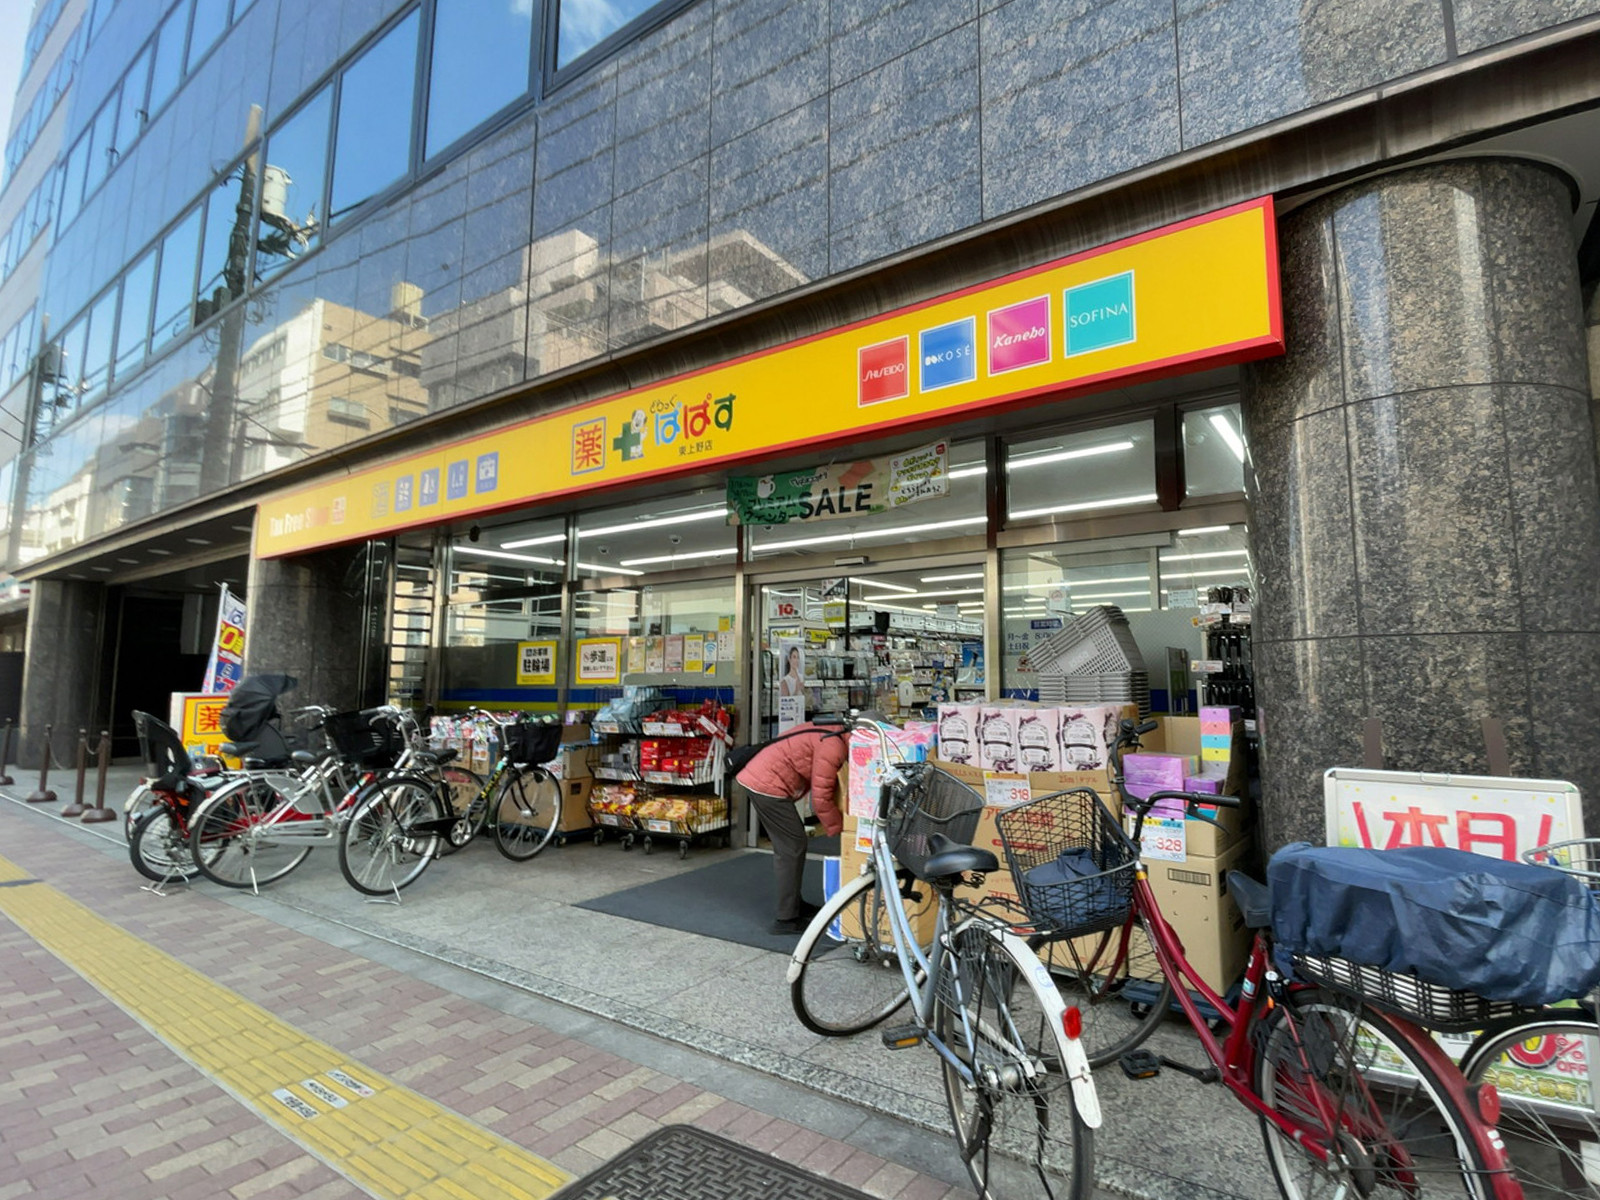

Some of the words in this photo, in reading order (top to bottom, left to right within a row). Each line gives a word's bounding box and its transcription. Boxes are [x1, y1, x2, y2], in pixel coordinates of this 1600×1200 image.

[1069, 301, 1129, 328] SOFINA
[993, 326, 1046, 349] Kanebo
[862, 363, 905, 382] SHISEIDO
[655, 393, 736, 446] ぱぱす
[575, 425, 602, 469] 薬
[678, 440, 713, 456] 東上野店
[799, 483, 873, 519] SALE
[1010, 788, 1030, 801] 318
[1155, 838, 1183, 852] 328
[1556, 1060, 1589, 1075] OFF
